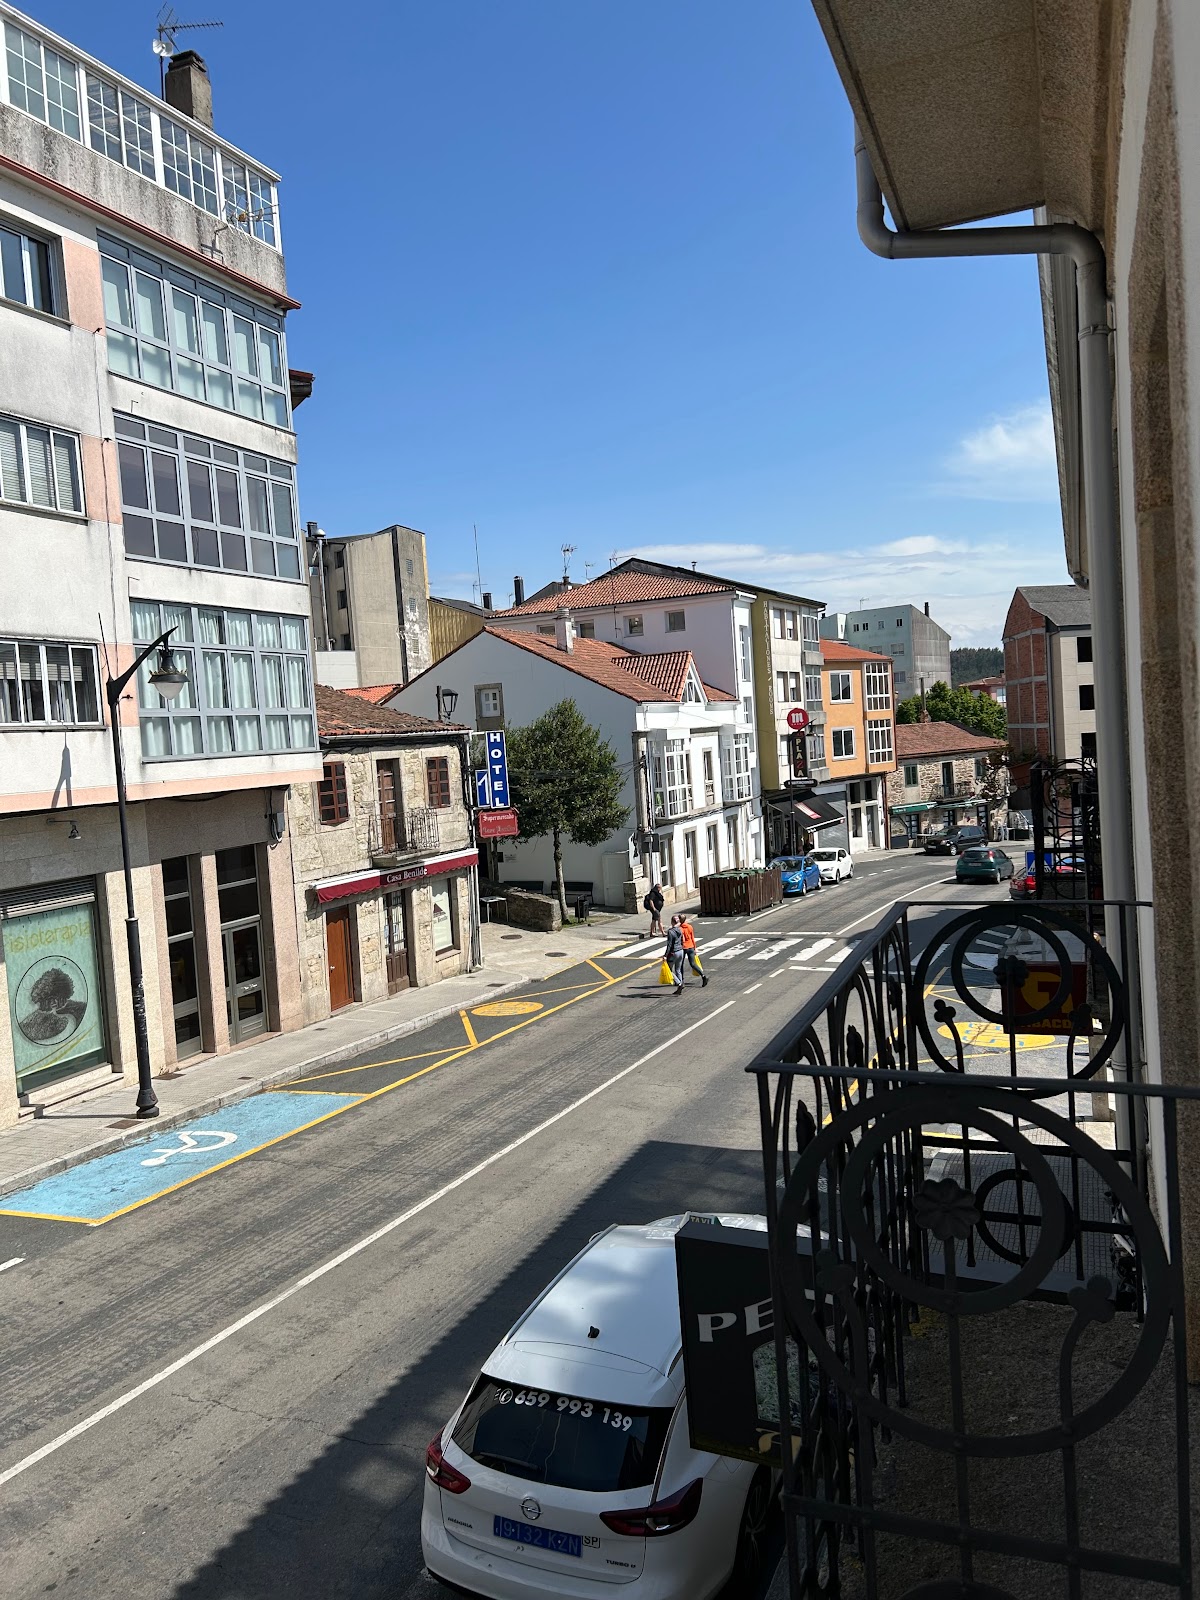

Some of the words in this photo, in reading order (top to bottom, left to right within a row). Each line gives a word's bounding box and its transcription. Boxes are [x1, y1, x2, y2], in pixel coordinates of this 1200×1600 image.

[763, 601, 772, 674] HABITACIONES
[490, 732, 504, 807] HOTEL
[795, 738, 804, 777] PLAZA
[386, 874, 402, 883] Casa
[403, 867, 428, 880] Benilde
[514, 1390, 550, 1408] 659
[556, 1396, 594, 1418] 993
[602, 1407, 633, 1432] 139
[503, 1520, 543, 1546] 9132
[548, 1530, 578, 1555] KZN
[583, 1536, 599, 1546] SP
